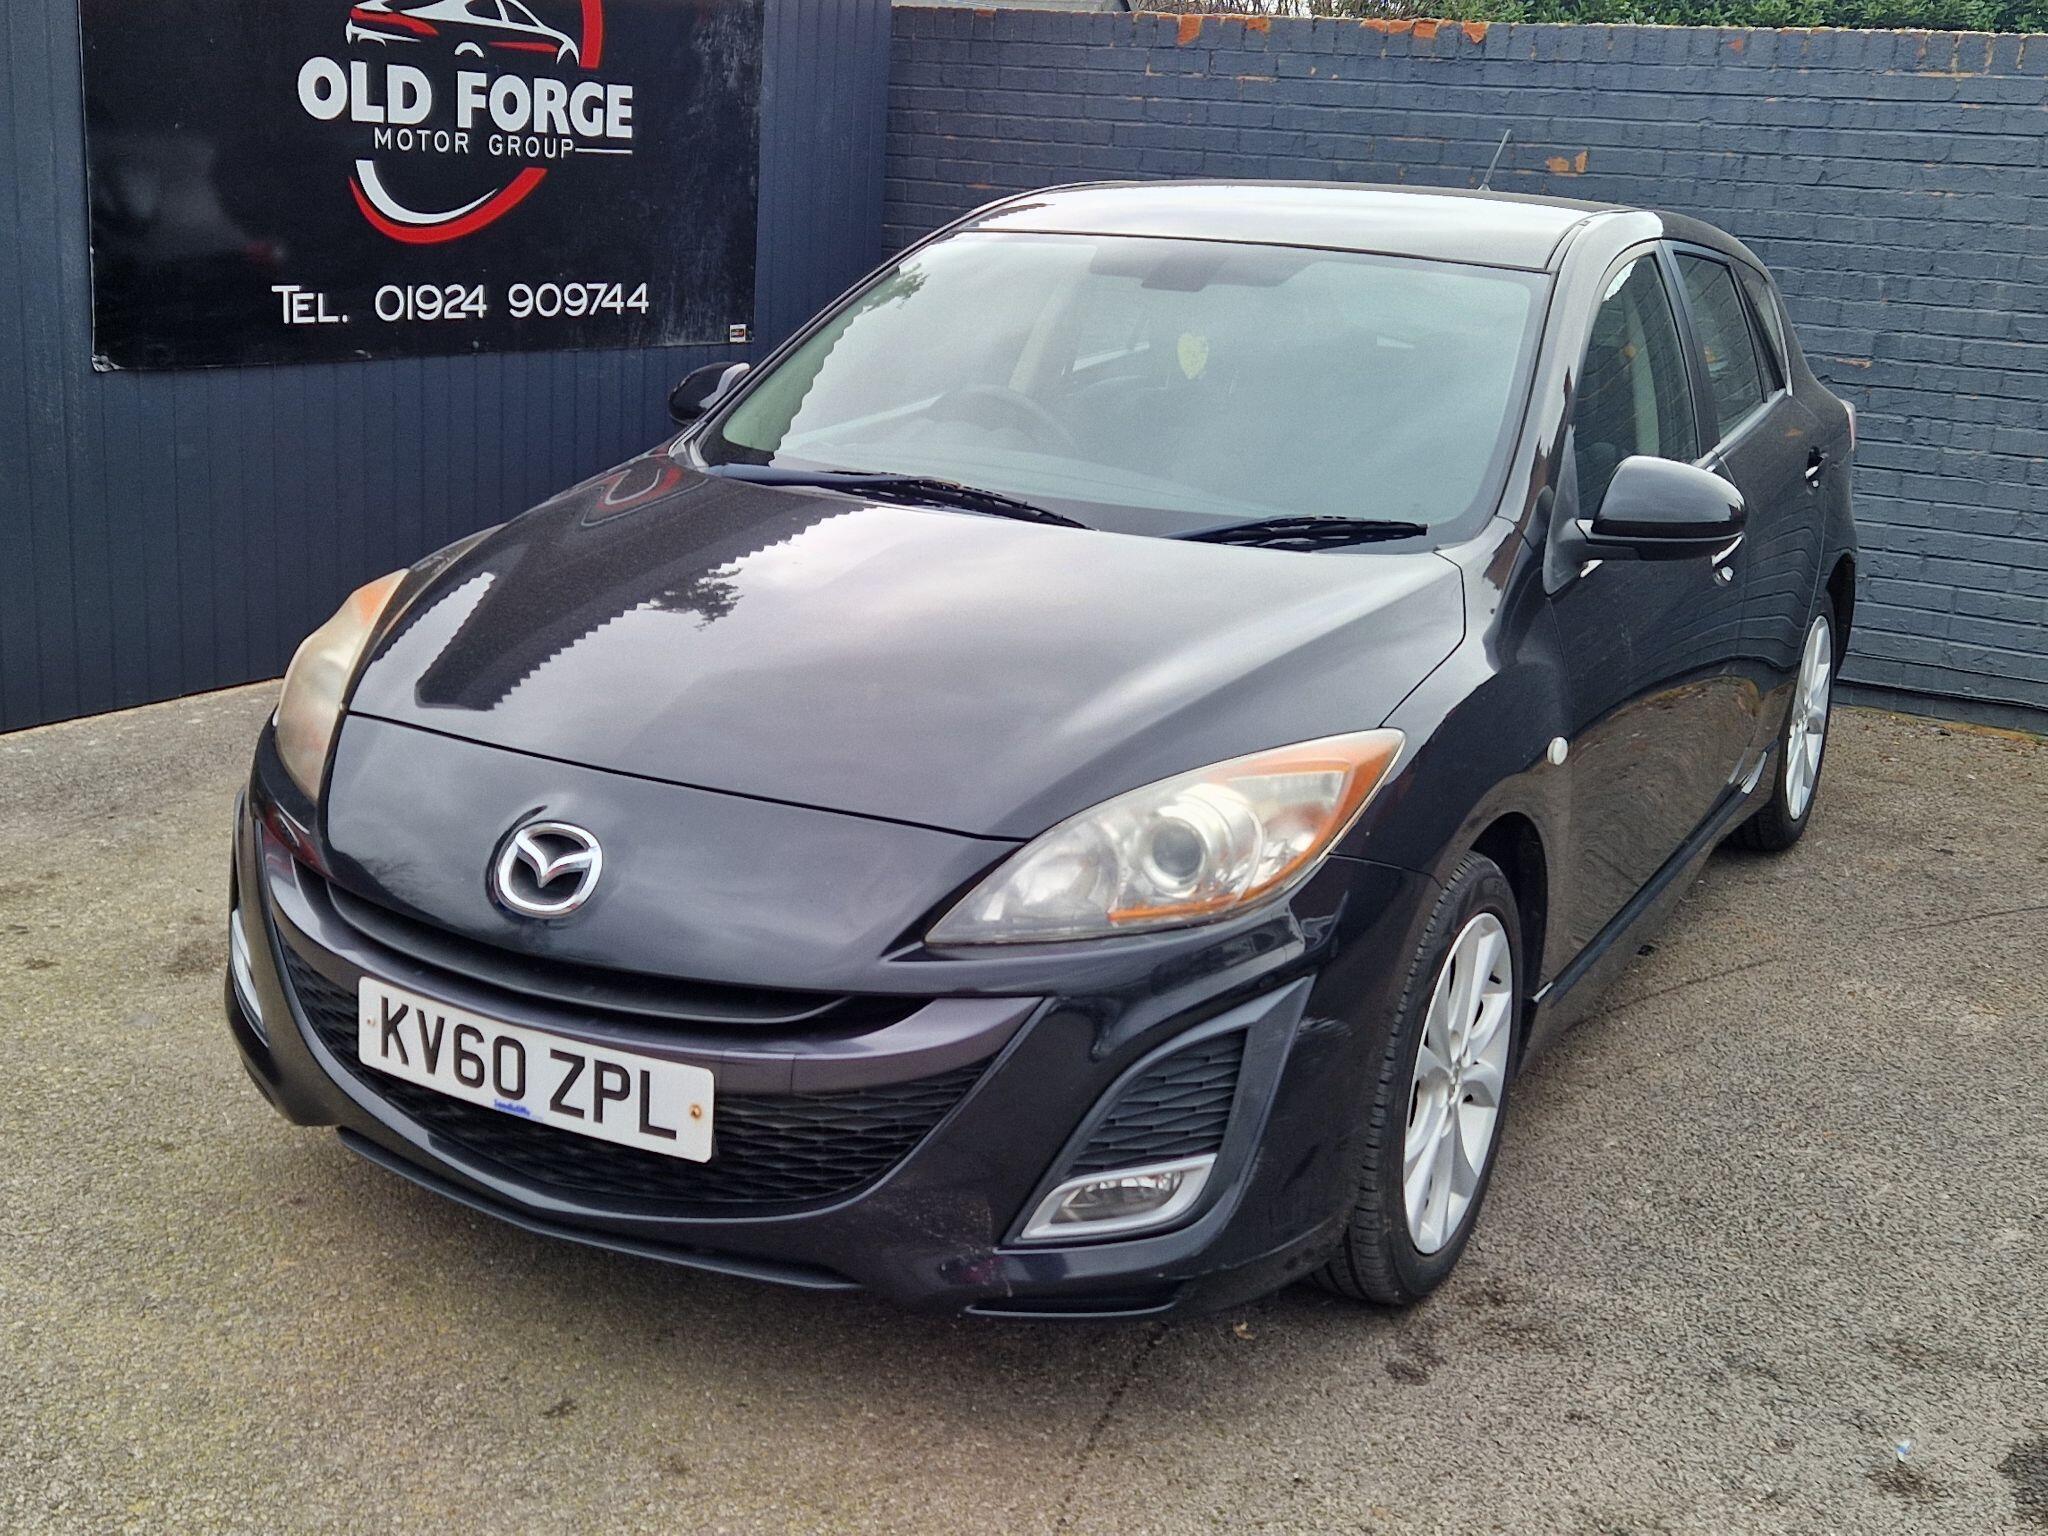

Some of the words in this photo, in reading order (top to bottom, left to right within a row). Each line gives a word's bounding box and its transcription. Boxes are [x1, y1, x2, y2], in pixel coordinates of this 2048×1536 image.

[297, 56, 433, 126] OLD
[456, 70, 633, 139] FORGE
[374, 127, 469, 156] MOTOR
[488, 134, 574, 159] GROUP
[374, 284, 488, 322] 01924
[508, 282, 650, 318] 909744
[380, 996, 527, 1101] KV60
[549, 1048, 677, 1141] ZPL
